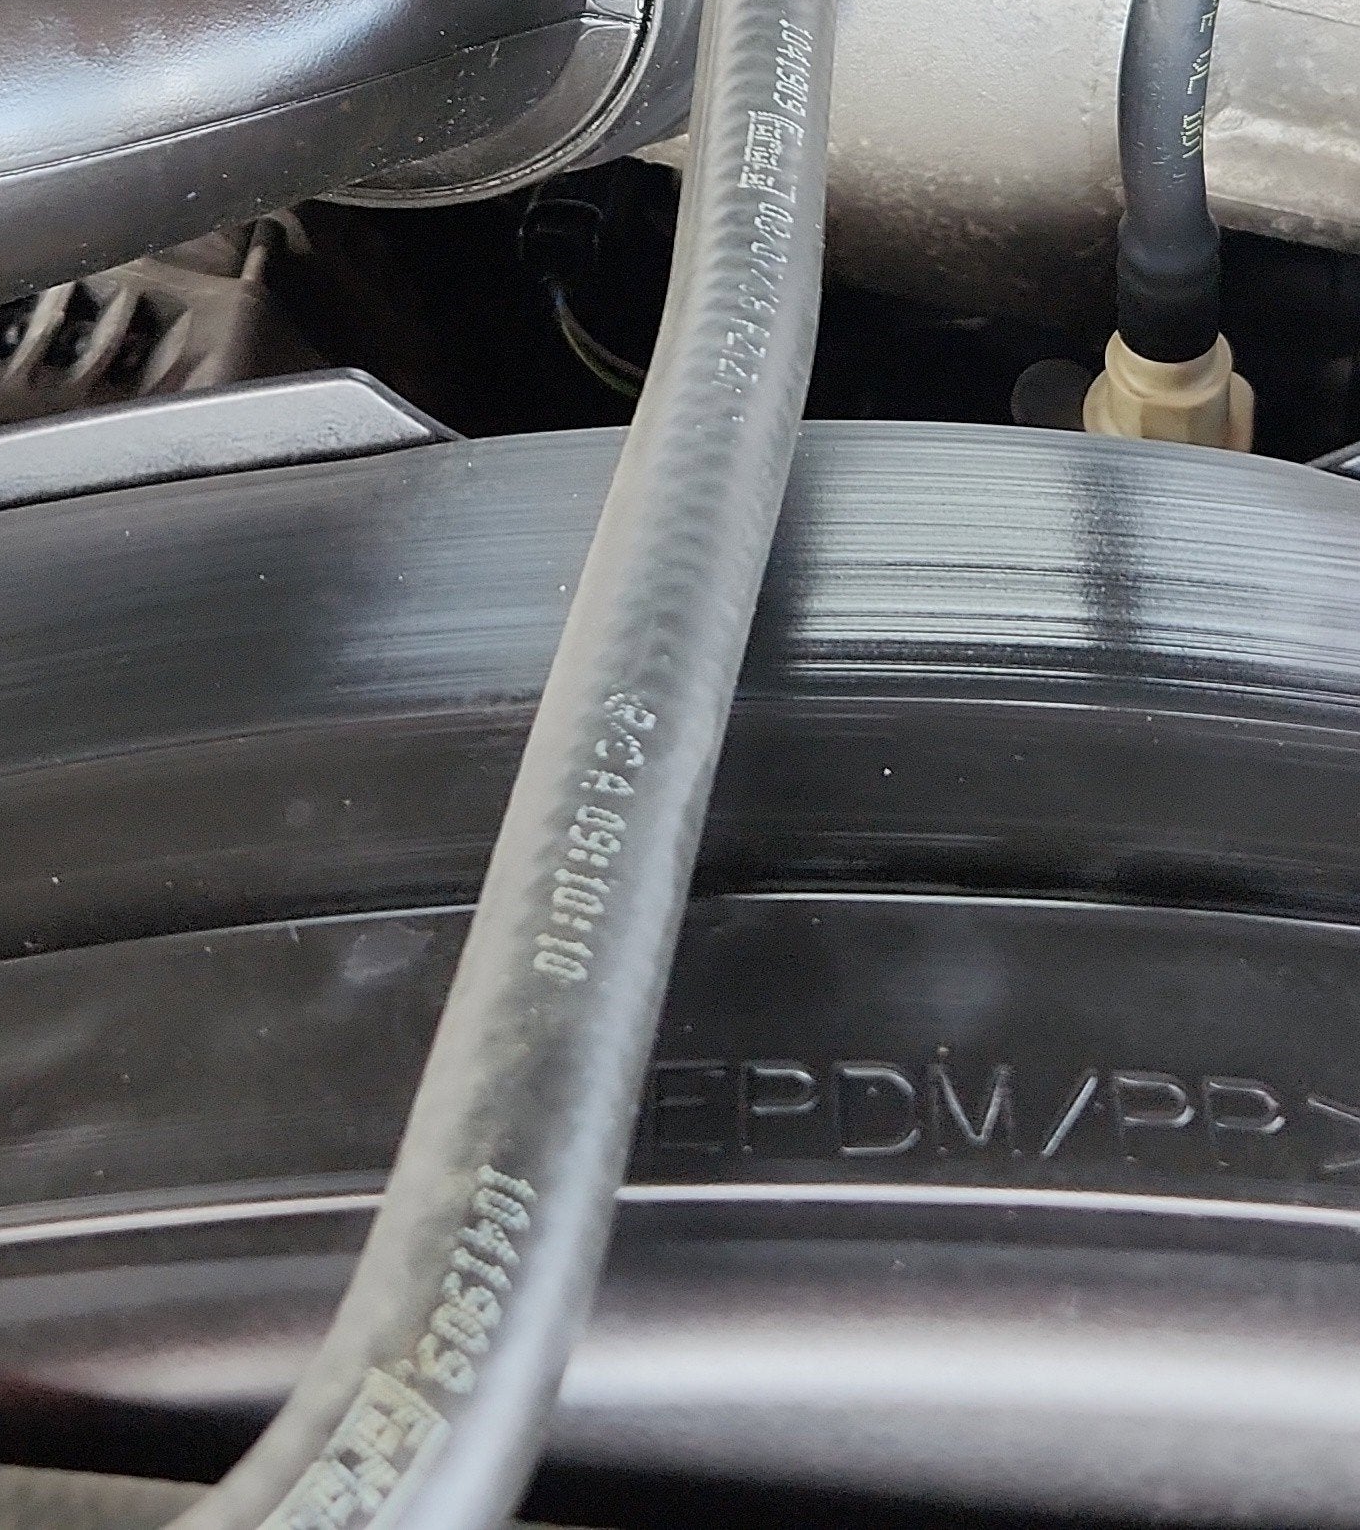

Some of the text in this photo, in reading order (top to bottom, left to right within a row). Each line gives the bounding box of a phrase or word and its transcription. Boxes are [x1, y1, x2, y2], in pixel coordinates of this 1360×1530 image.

[772, 18, 814, 118] 1041909
[533, 804, 627, 981] 09:10:10
[416, 1164, 539, 1394] 1041909
